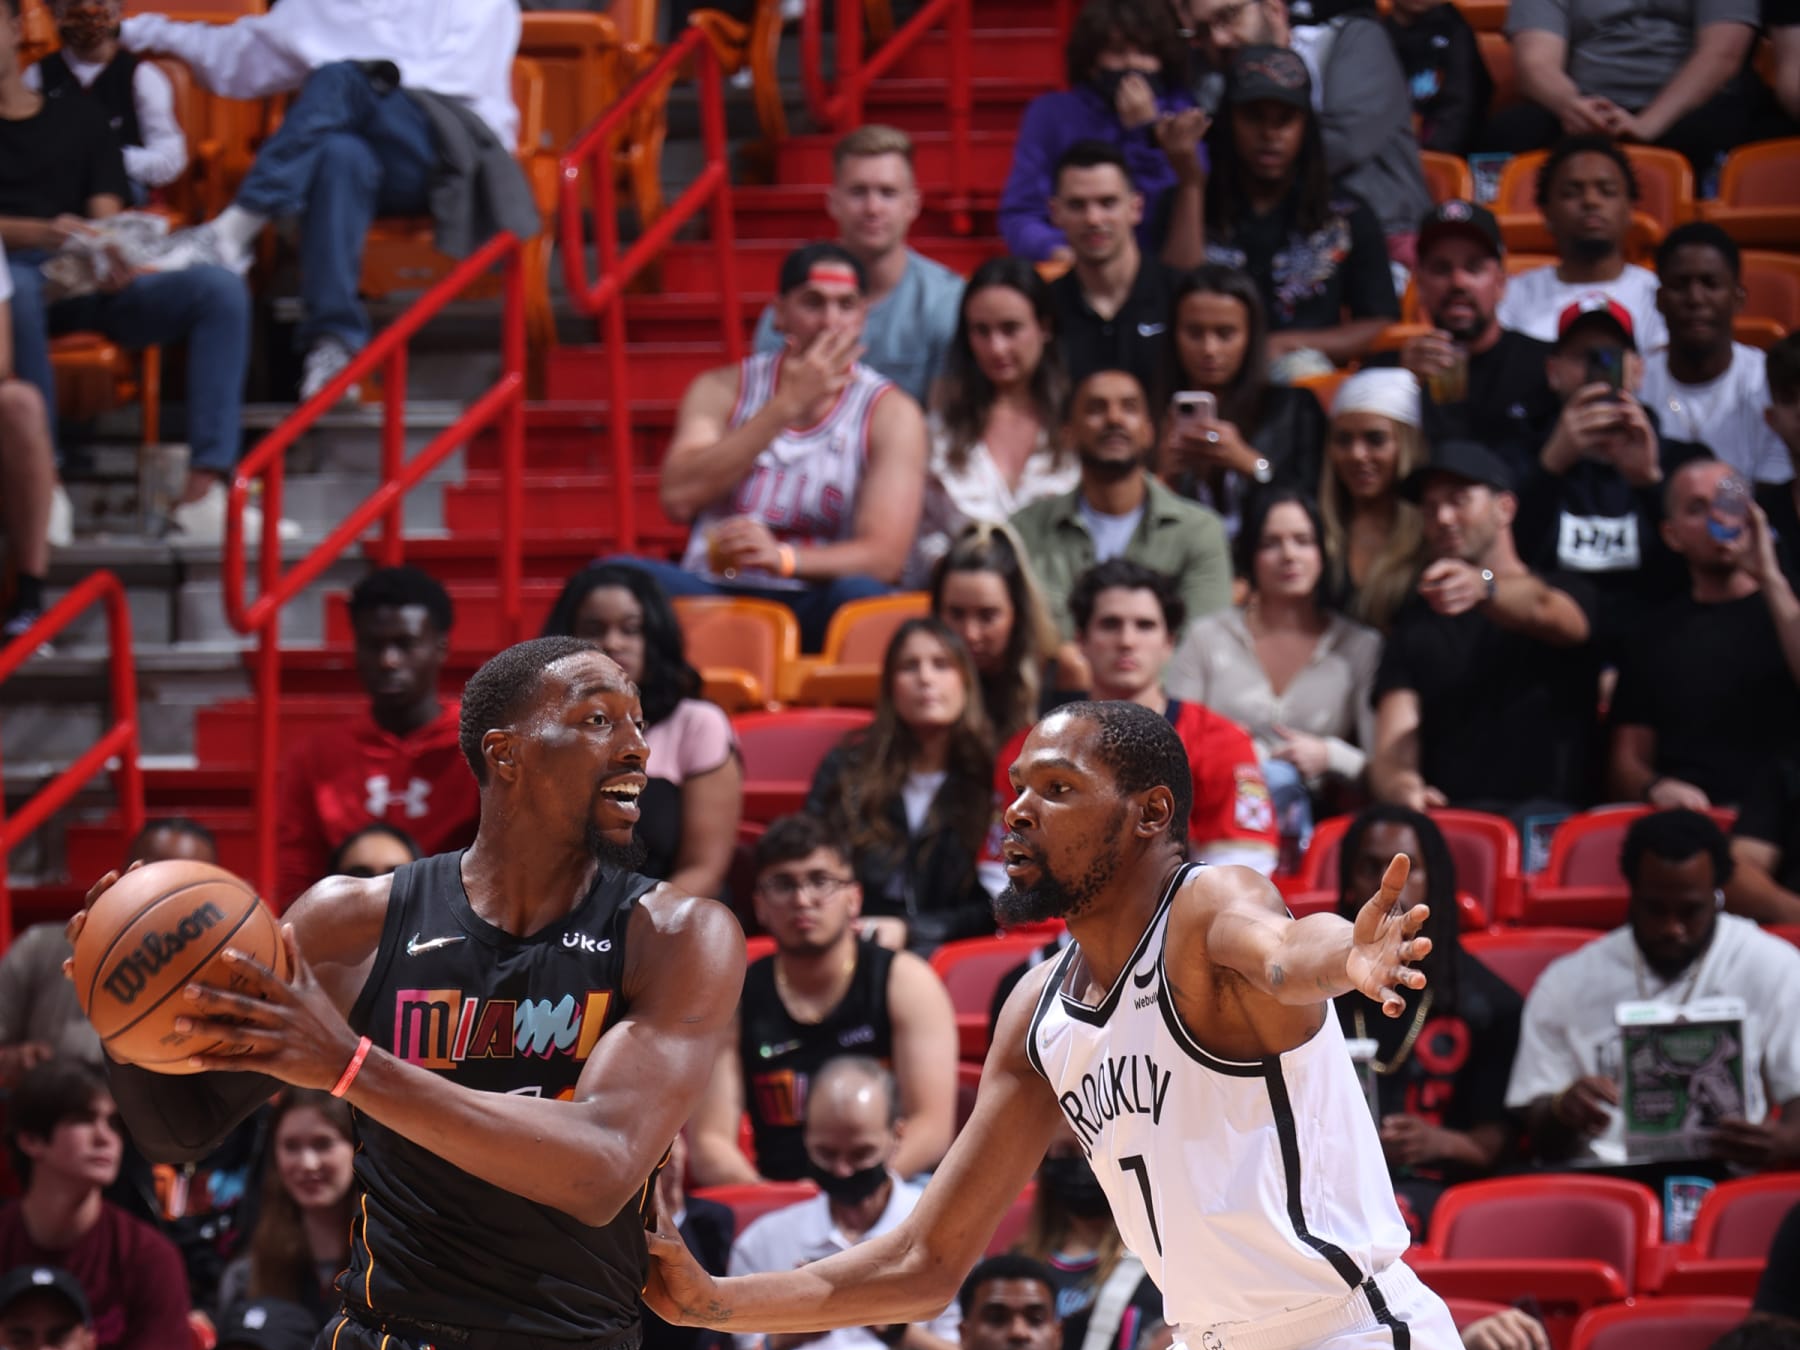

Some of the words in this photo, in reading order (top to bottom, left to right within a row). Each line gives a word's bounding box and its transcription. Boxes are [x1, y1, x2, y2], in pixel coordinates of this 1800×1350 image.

[738, 465, 845, 528] ULLS
[103, 902, 227, 1005] Wilson
[394, 989, 613, 1070] MIAMI
[1118, 1154, 1163, 1258] 7
